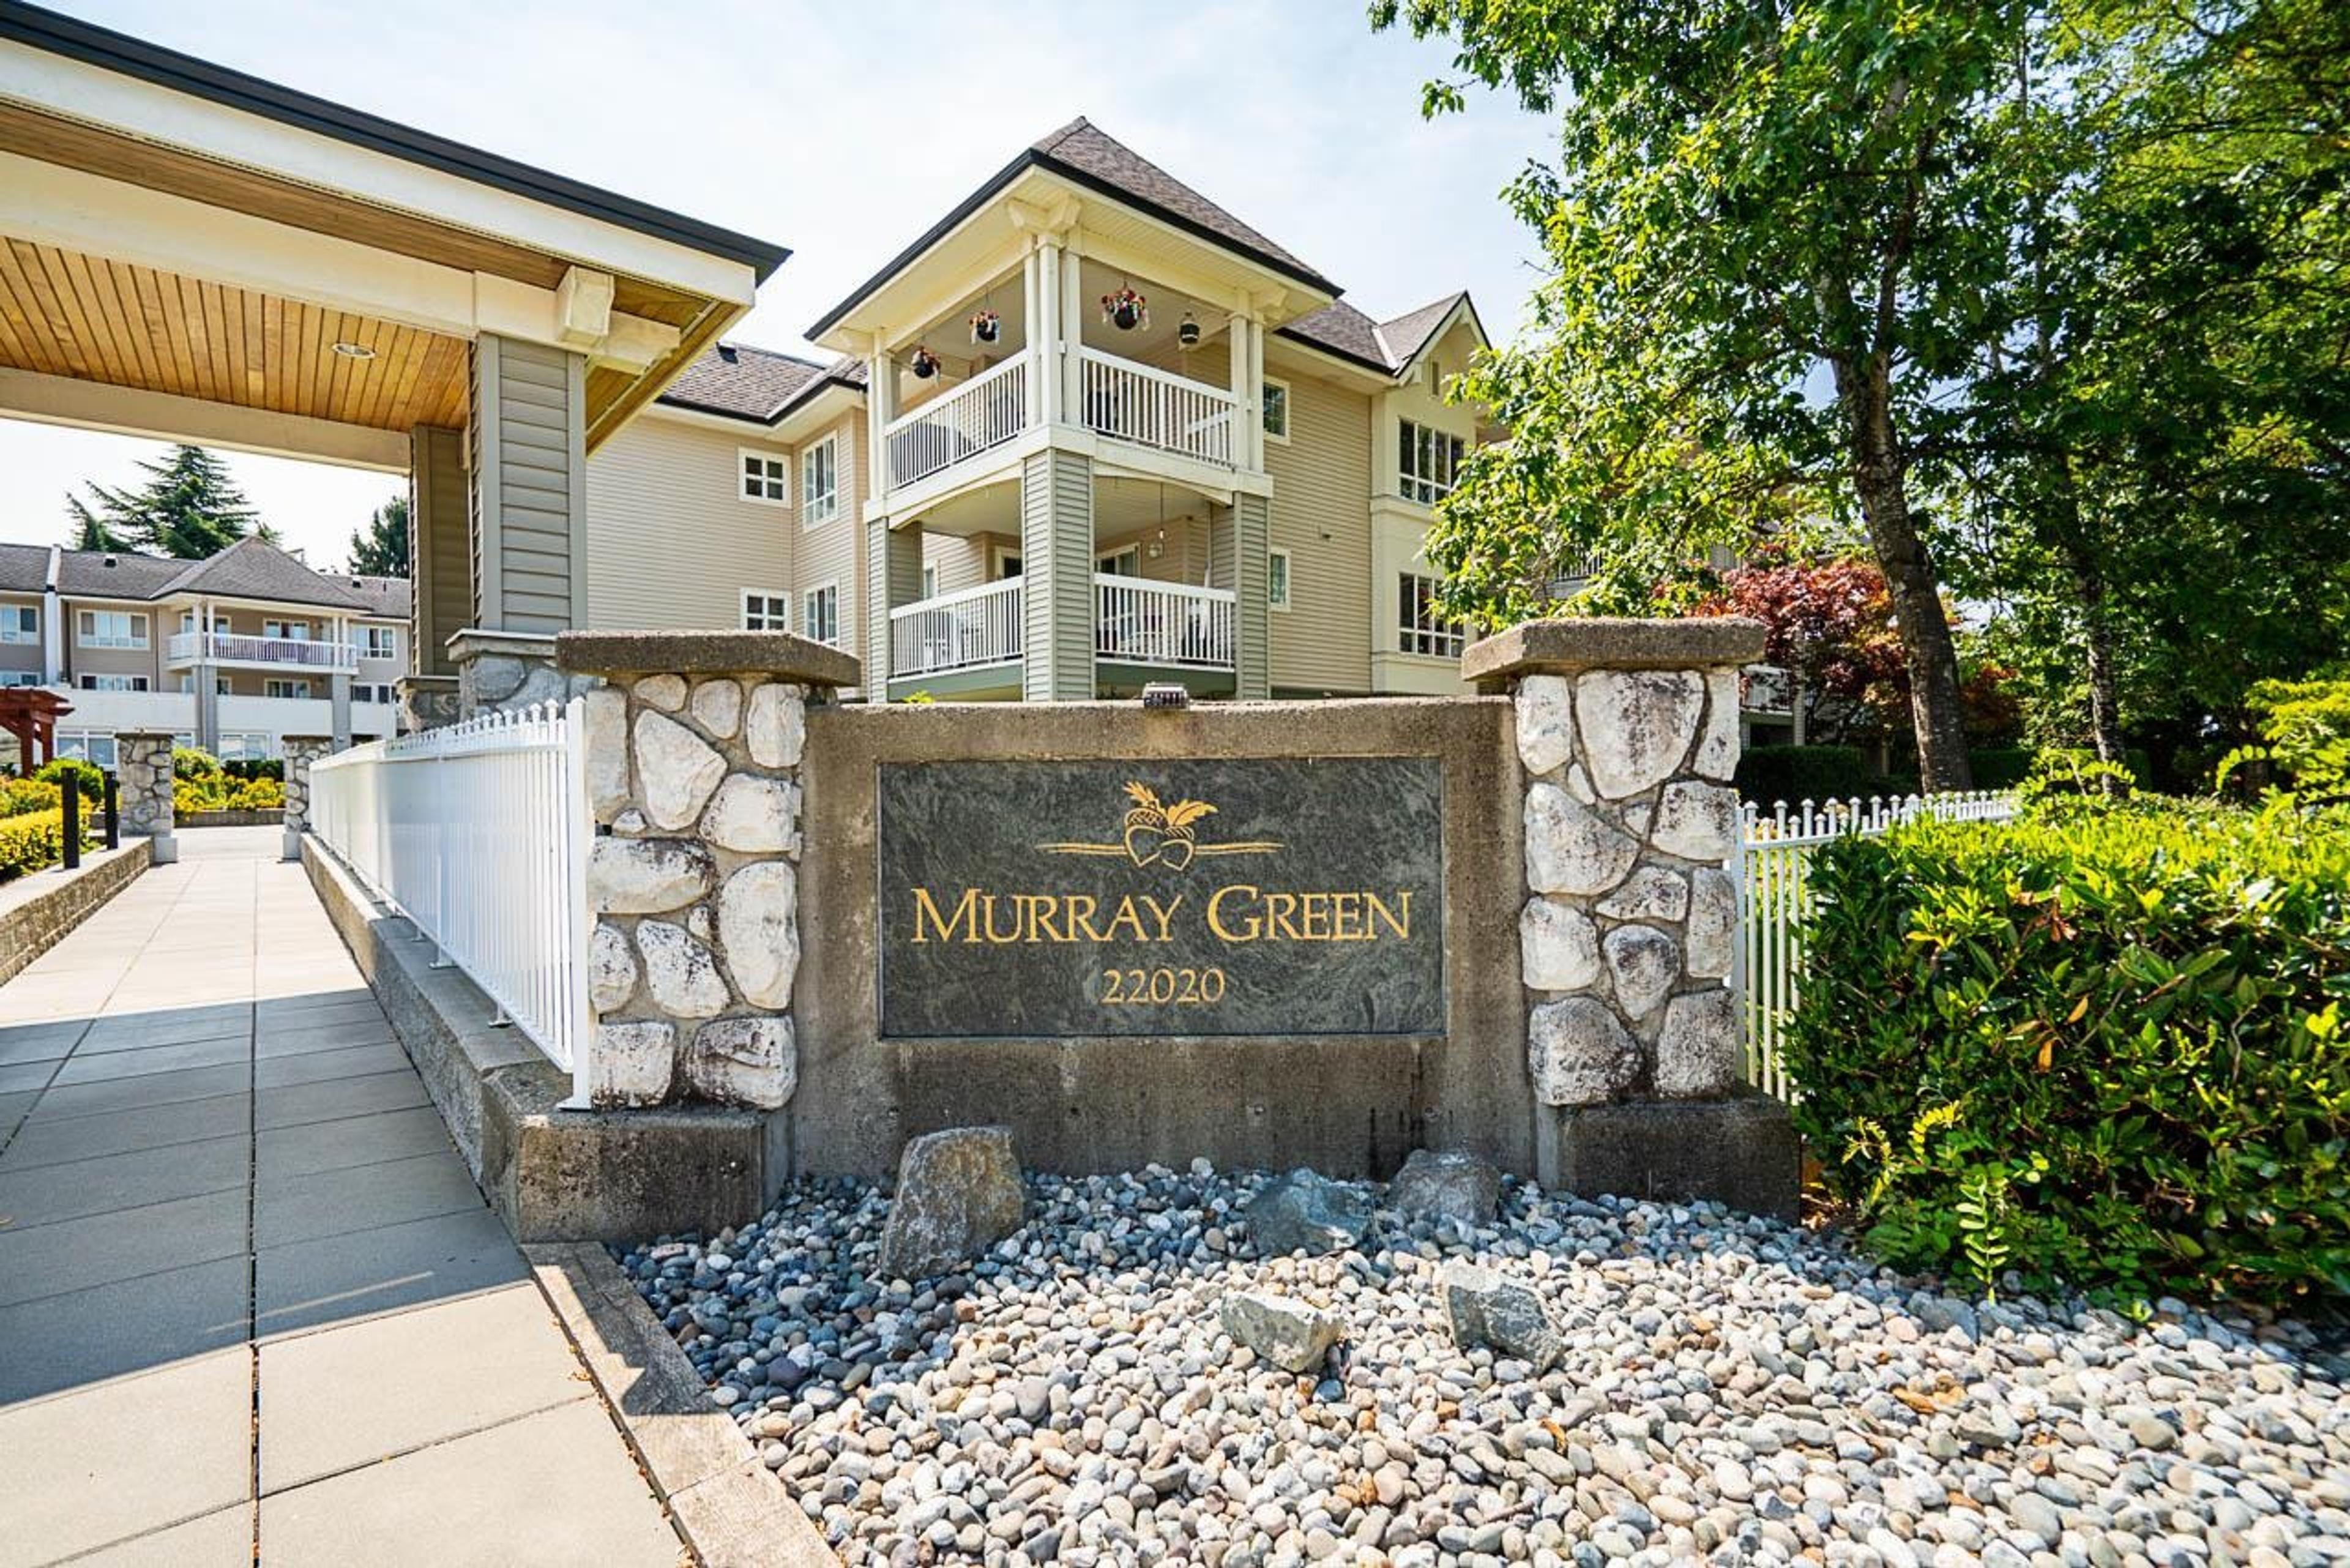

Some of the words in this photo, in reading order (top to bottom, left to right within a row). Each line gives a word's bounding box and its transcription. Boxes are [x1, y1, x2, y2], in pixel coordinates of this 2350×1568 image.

[911, 887, 1183, 943] MURRAY
[1206, 884, 1412, 943] GREEN
[1102, 968, 1226, 1004] 22020
